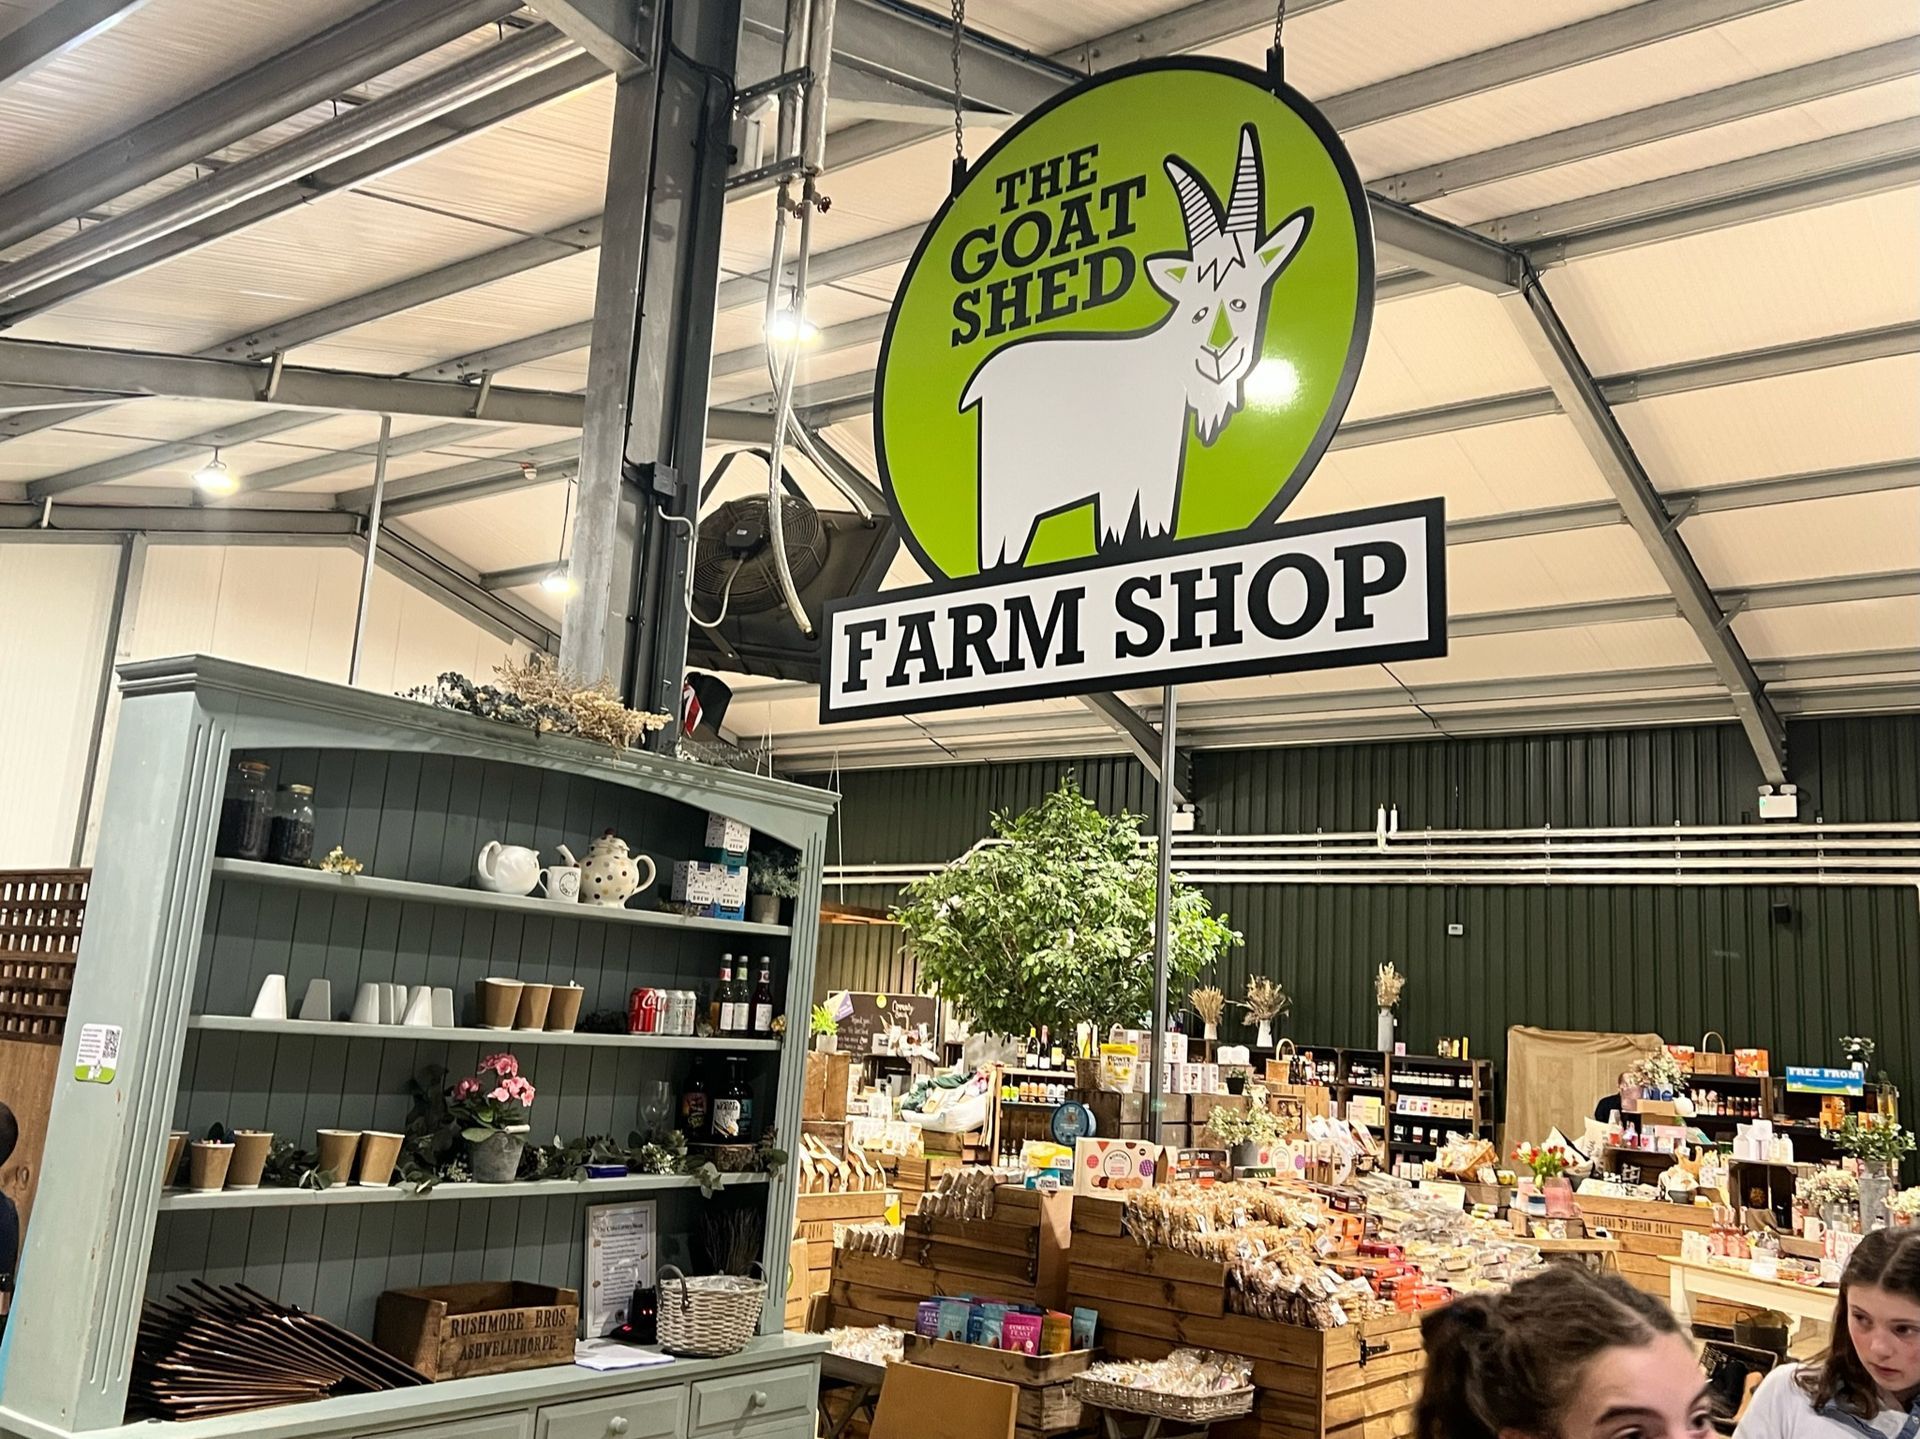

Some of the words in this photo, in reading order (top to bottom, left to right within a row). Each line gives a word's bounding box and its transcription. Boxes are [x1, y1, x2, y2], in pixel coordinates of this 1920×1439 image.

[995, 144, 1099, 214] THE
[951, 174, 1147, 284] GOAT
[951, 246, 1136, 348] SHED
[841, 587, 1086, 693] FARM
[1115, 541, 1407, 659] SHOP
[1788, 1067, 1820, 1077] FREE
[1823, 1069, 1860, 1080] FROM
[450, 1312, 525, 1338] RUSHMORE
[534, 1308, 568, 1328] BROS.
